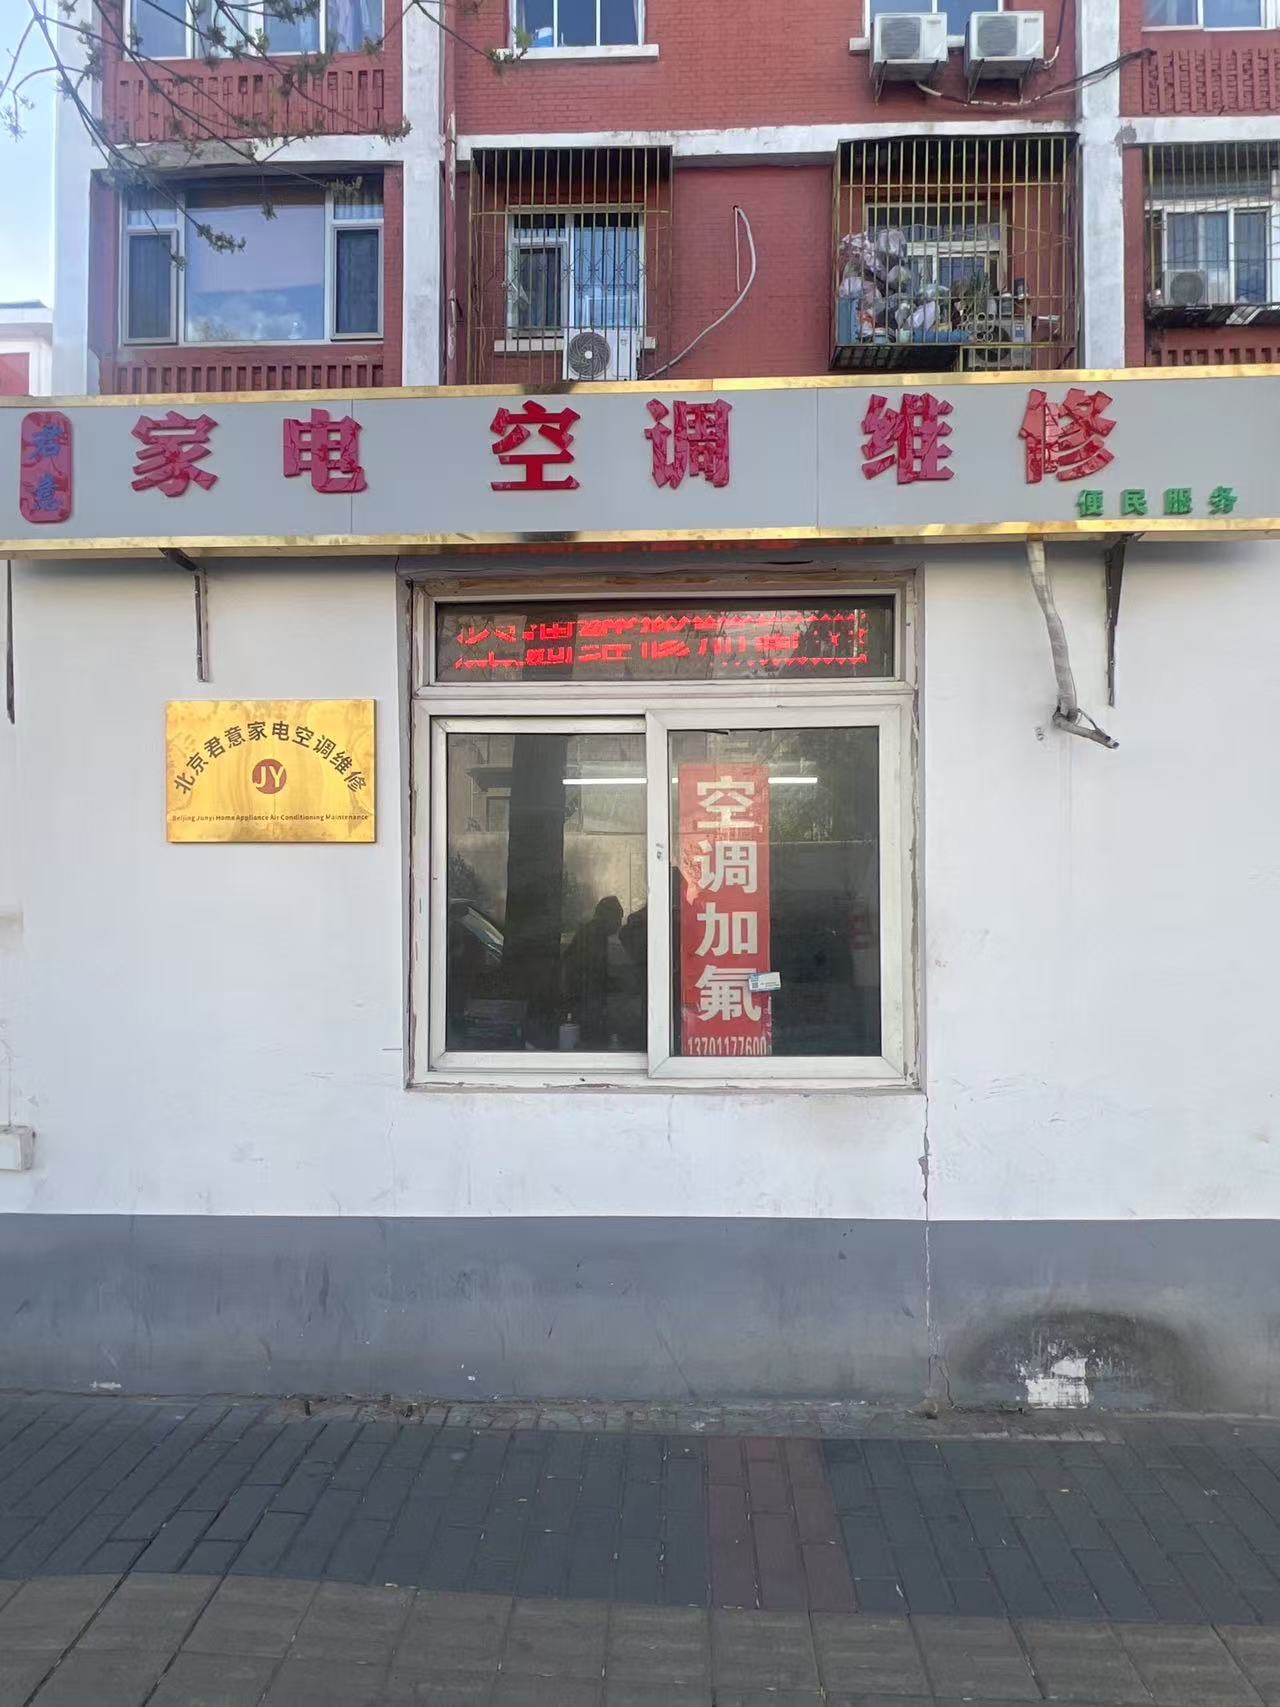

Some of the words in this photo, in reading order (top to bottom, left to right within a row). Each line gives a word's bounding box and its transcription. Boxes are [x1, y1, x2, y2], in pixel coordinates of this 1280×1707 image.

[131, 388, 1116, 498] 家电空调维修
[1076, 486, 1238, 517] 便民服务
[174, 720, 367, 794] 北京君意家电空调维修
[694, 775, 762, 1021] 空调加氟
